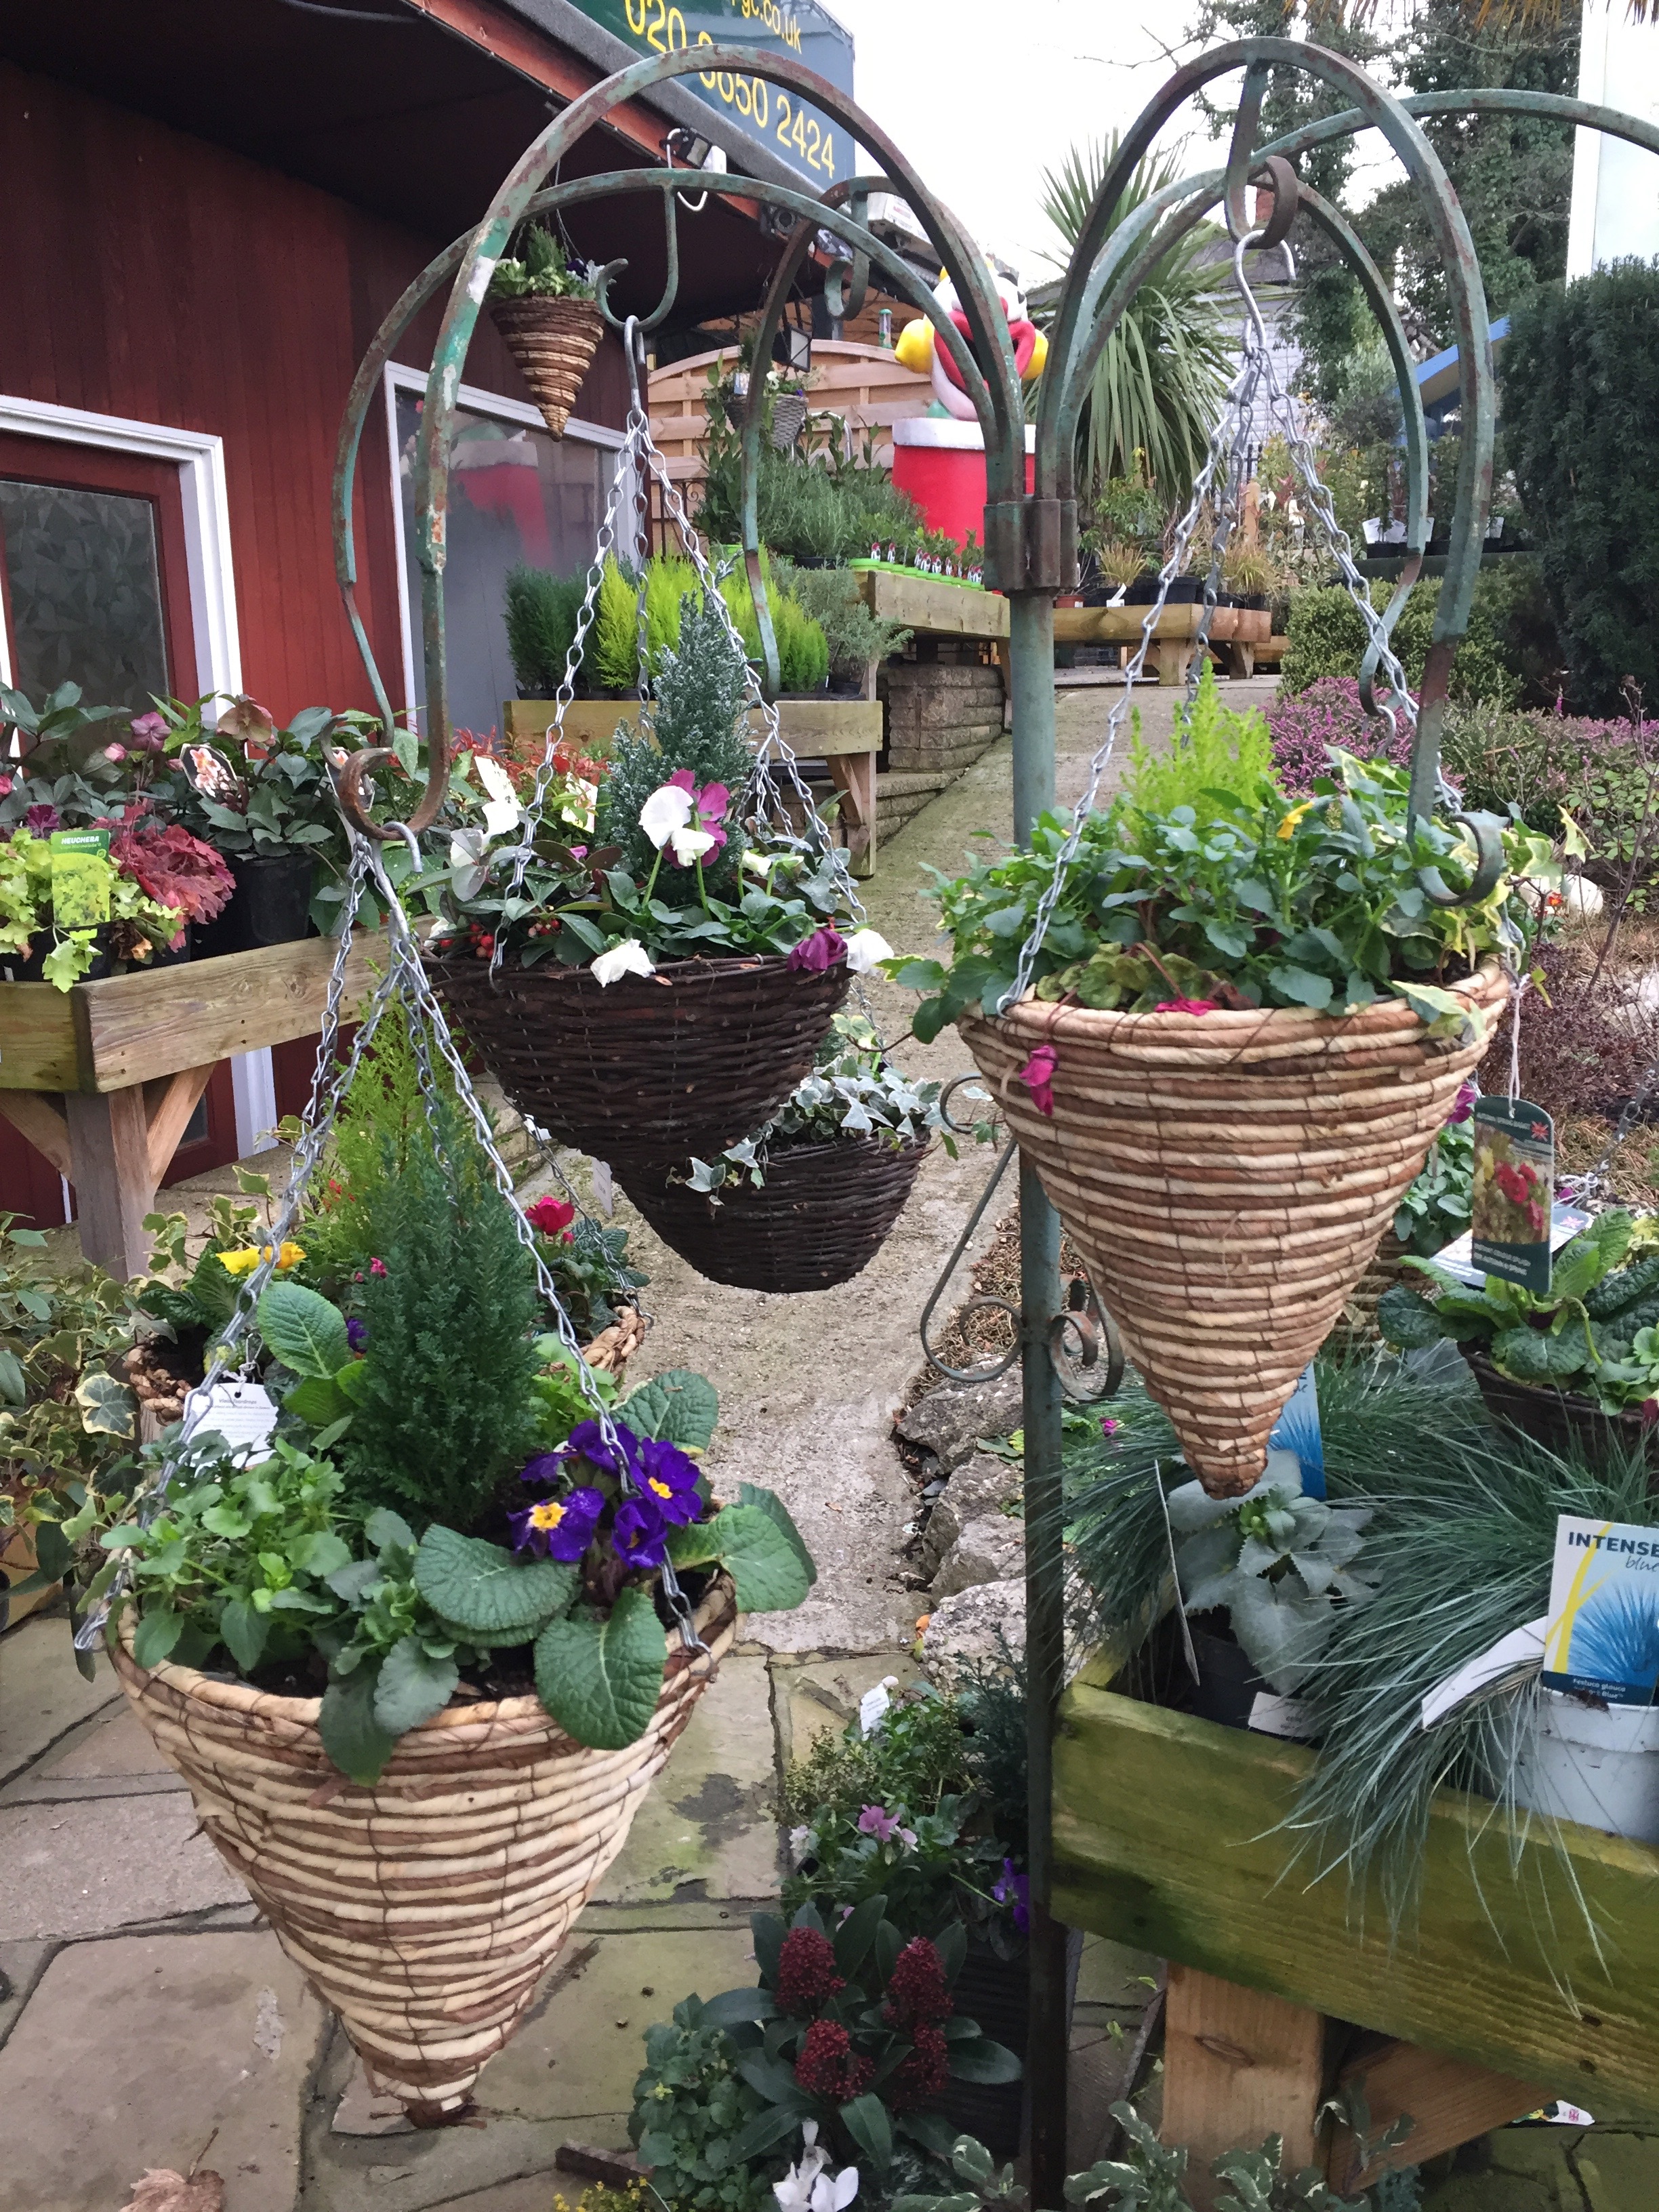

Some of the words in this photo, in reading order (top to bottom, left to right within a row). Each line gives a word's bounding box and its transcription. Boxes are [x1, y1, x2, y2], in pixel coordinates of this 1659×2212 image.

[625, 0, 687, 53] 020
[777, 94, 835, 179] 2424
[61, 835, 100, 844] HEUCHERA
[1568, 1531, 1659, 1558] INTENSE
[1573, 1678, 1600, 1688] Festuca
[1601, 1683, 1626, 1692] glauca
